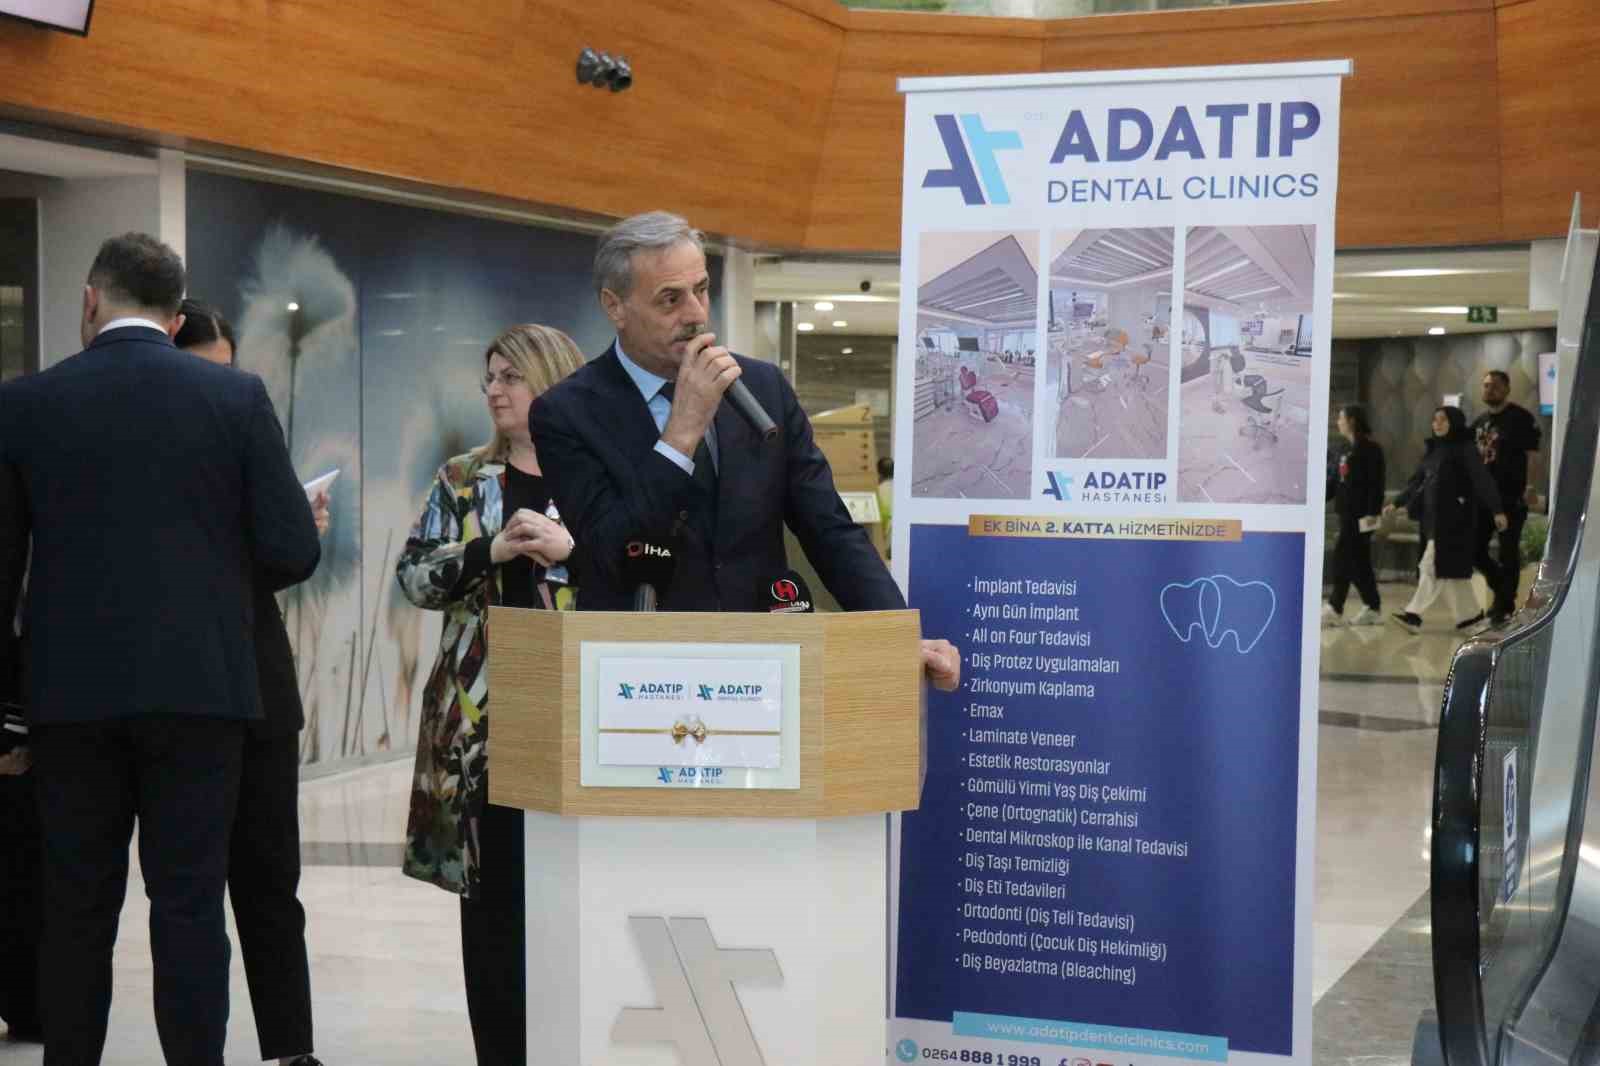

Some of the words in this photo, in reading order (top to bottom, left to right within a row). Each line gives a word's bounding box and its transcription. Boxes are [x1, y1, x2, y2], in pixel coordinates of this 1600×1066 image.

[1050, 101, 1320, 163] ADATIP
[1047, 176, 1172, 203] DENTAL
[1183, 173, 1319, 199] CLINICS
[1083, 471, 1167, 489] ADATIP
[984, 519, 1001, 532] EK
[1006, 518, 1041, 533] BİNA
[1045, 522, 1058, 534] 2.
[1063, 522, 1114, 535] KATTA
[1119, 520, 1225, 537] HİZMETİNİZDE
[1026, 580, 1077, 595] Tedavisi
[973, 604, 999, 620] Aynı
[1002, 604, 1026, 617] Gün
[1030, 603, 1079, 622] İmplant
[972, 628, 987, 642] All
[991, 631, 1005, 643] on
[1009, 630, 1036, 645] Four
[1039, 631, 1091, 646] Tedavisi
[972, 653, 991, 671] Diş
[994, 655, 1032, 670] Protez
[1036, 656, 1119, 673] Uygulamaları
[639, 683, 684, 694] ADATIP
[718, 684, 762, 695] ADATIP
[971, 679, 1035, 697] Zirkonyum
[1039, 681, 1095, 699] Kaplama
[970, 703, 1004, 718] Emax
[970, 728, 1028, 745] Laminate
[1031, 731, 1076, 747] Veneer
[969, 753, 1011, 768] Estetik
[1014, 755, 1110, 775] Restorasyonlar
[968, 778, 1015, 794] Gömülü
[1019, 782, 1050, 796] Yirmi
[1054, 783, 1076, 799] Yaş
[1080, 785, 1098, 802] Diş
[1102, 785, 1146, 803] Çekimi
[967, 803, 999, 819] Çene
[1002, 804, 1078, 826] (Ortognatik)
[1081, 810, 1138, 827] Cerrahisi
[966, 828, 1007, 844] Dental
[1010, 830, 1074, 852] Mikroskop
[1096, 837, 1132, 852] Kanal
[1136, 839, 1188, 857] Tedavisi
[965, 853, 985, 870] Diş
[987, 855, 1011, 870] Taşı
[1015, 856, 1069, 876] Temizliği
[965, 878, 984, 896] Diş
[987, 880, 1002, 894] Eti
[1005, 881, 1066, 899] Tedavileri
[964, 903, 1022, 921] Ortodonti
[1026, 905, 1050, 925] (Diş
[1053, 909, 1074, 925] Teli
[1077, 911, 1134, 933] Tedavisi)
[963, 928, 1027, 947] Pedodonti
[1030, 932, 1074, 952] (Çocuk
[1078, 938, 1097, 956] Diş
[1101, 940, 1167, 962] Hekimliği)
[963, 953, 982, 971] Diş
[985, 956, 1057, 976] Beyazlatma
[1061, 961, 1136, 985] (Bleaching)
[986, 1021, 1210, 1054] www.adatipdentalclinics.com
